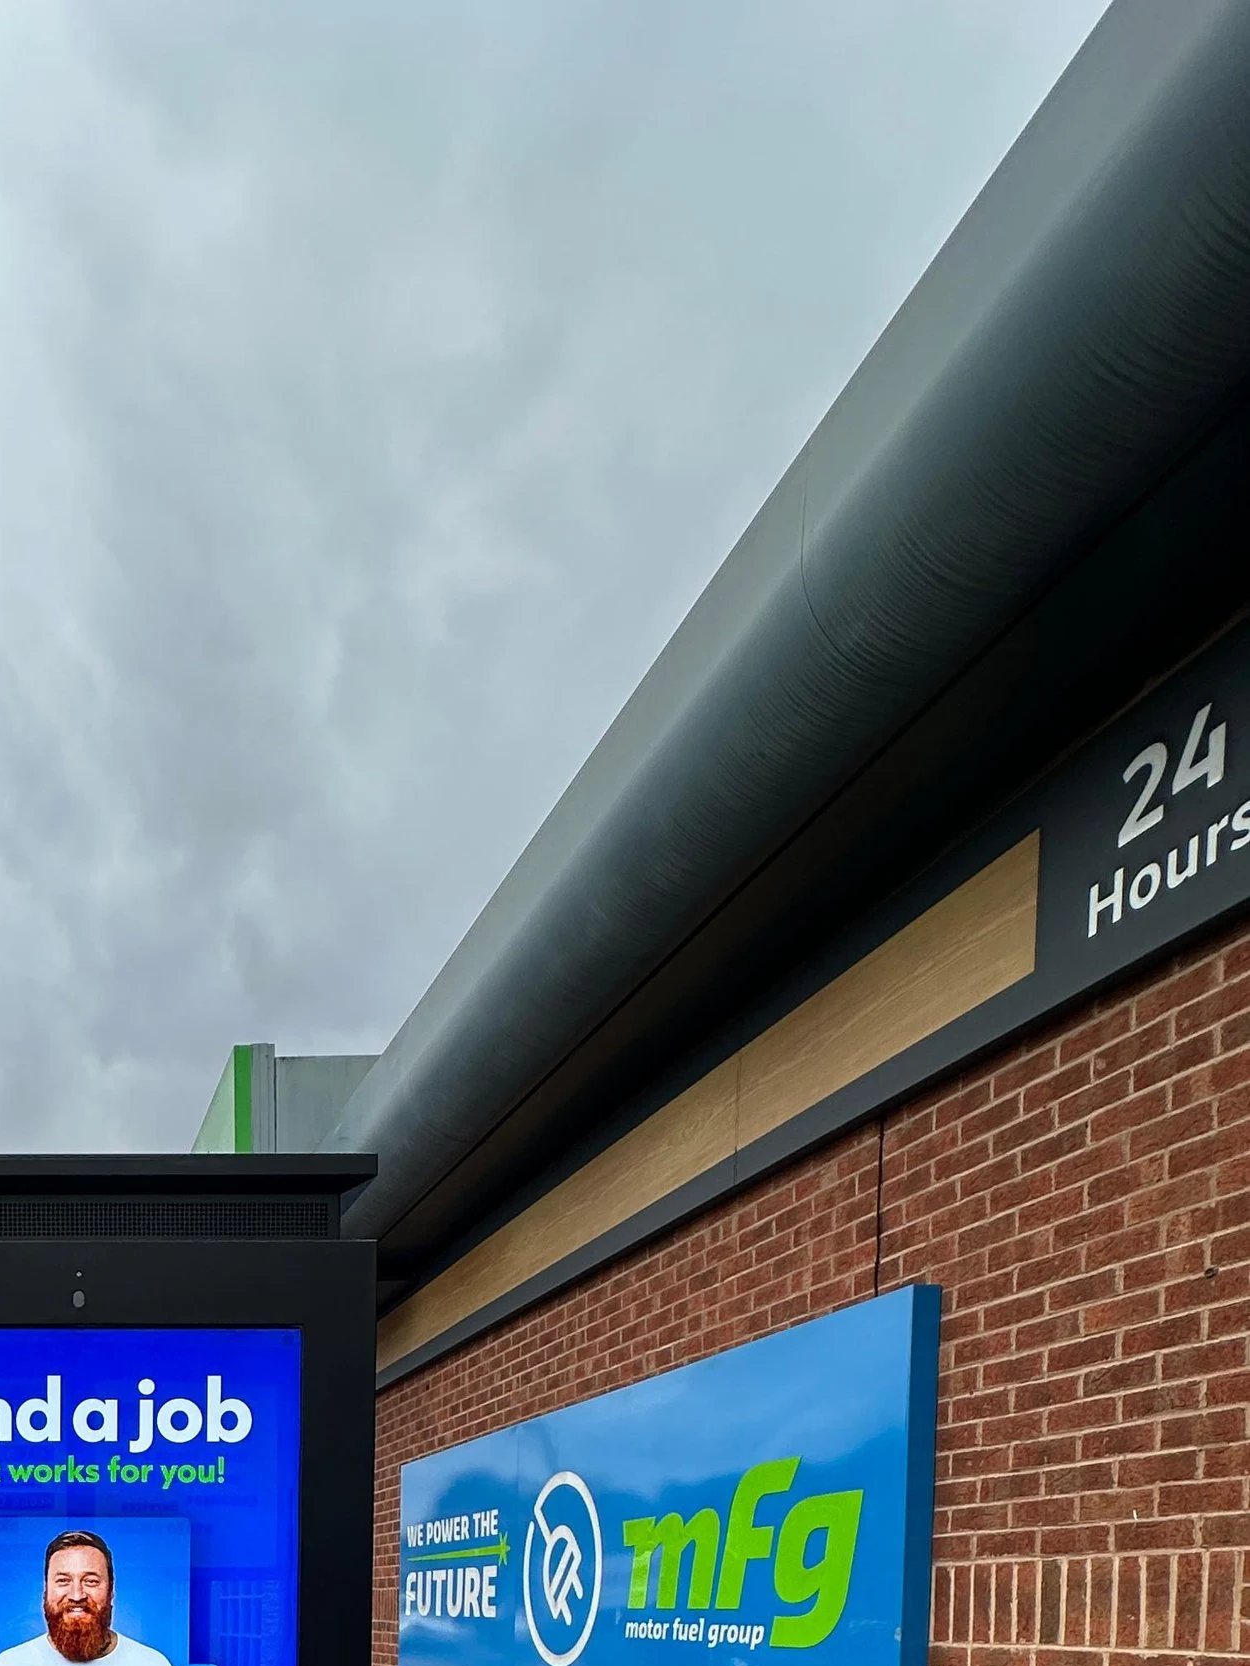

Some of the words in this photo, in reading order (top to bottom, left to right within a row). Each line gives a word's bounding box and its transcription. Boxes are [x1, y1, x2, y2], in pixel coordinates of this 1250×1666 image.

[1117, 702, 1227, 848] 24
[1087, 800, 1250, 939] Hours
[72, 1398, 119, 1443] a
[129, 1375, 253, 1454] job
[8, 1454, 100, 1484] works
[108, 1454, 154, 1484] for
[161, 1456, 225, 1490] you!
[406, 1523, 424, 1548] WE
[426, 1515, 470, 1546] POWER
[472, 1508, 499, 1539] THE
[622, 1456, 864, 1648] mfg
[405, 1565, 498, 1618] FUTURE
[624, 1618, 670, 1640] motor
[672, 1617, 705, 1642] fuel
[707, 1623, 765, 1650] group
